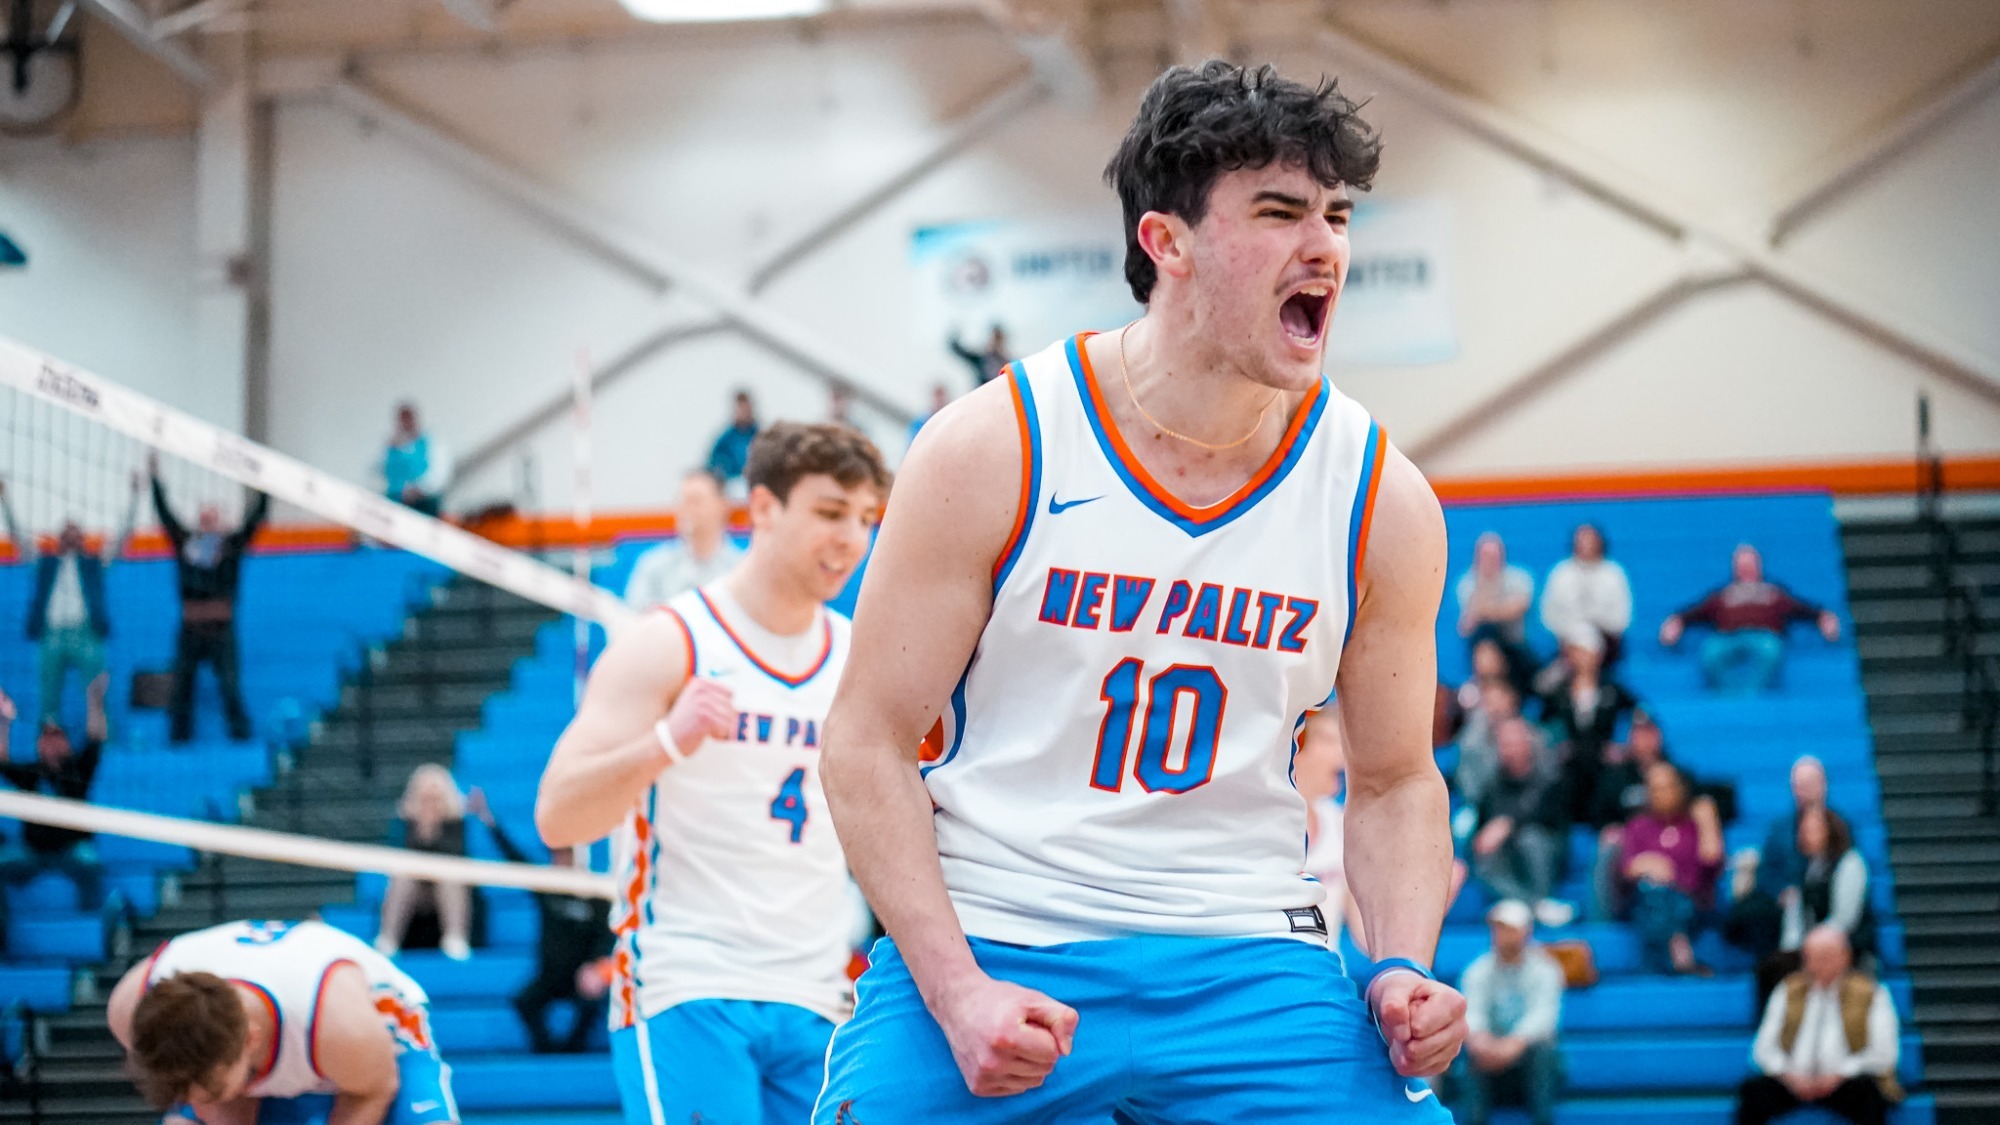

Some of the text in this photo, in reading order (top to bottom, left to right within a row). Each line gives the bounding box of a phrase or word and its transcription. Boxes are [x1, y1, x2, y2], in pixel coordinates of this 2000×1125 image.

[1038, 567, 1319, 653] NEW PALTZ
[736, 712, 773, 743] EW
[1089, 656, 1228, 795] 10
[769, 766, 809, 844] 4
